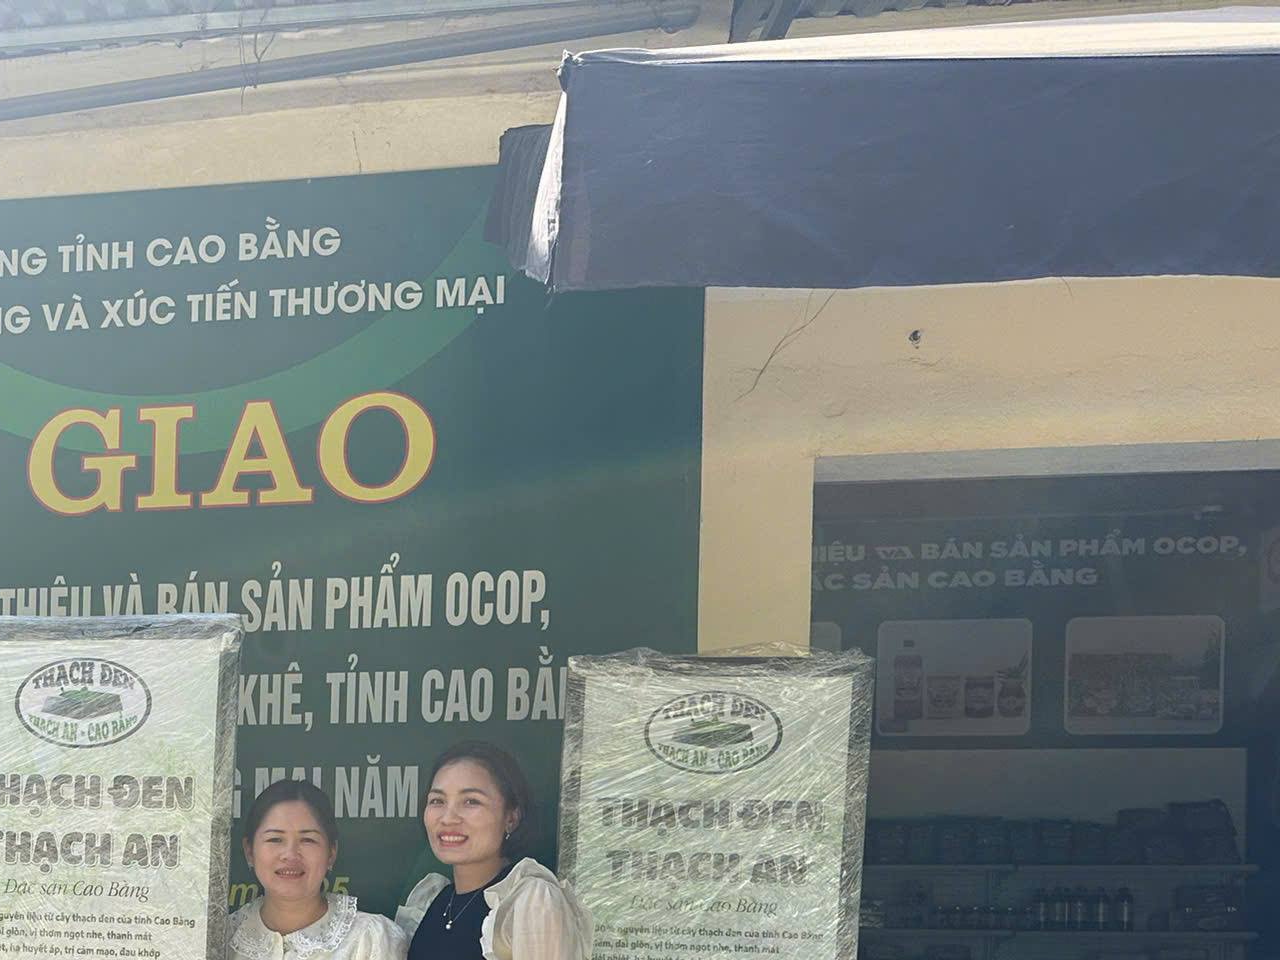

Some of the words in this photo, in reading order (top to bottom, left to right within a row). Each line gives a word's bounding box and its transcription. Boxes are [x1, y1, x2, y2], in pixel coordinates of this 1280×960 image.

[58, 233, 135, 273] TỈNH
[145, 234, 227, 268] CAO
[238, 216, 342, 262] BẰNG
[42, 293, 90, 333] VÀ
[100, 289, 177, 329] XÚC
[187, 279, 258, 323] TIẾN
[269, 279, 424, 317] THƯƠNG
[434, 275, 506, 315] MẠI
[26, 390, 437, 518] GIAO
[921, 537, 983, 560] BÁN
[241, 560, 314, 633] SẢN
[324, 552, 433, 630] PHẨM
[444, 569, 551, 631] OCOP,
[852, 565, 920, 590] SẢN
[927, 570, 997, 589] CAO
[237, 661, 314, 732] KHÊ,
[326, 653, 409, 725] TỈNH
[420, 668, 494, 723] CAO
[108, 774, 196, 811] ĐEN
[334, 754, 419, 818] NĂM
[121, 833, 181, 870] AN
[73, 880, 104, 896] Cao
